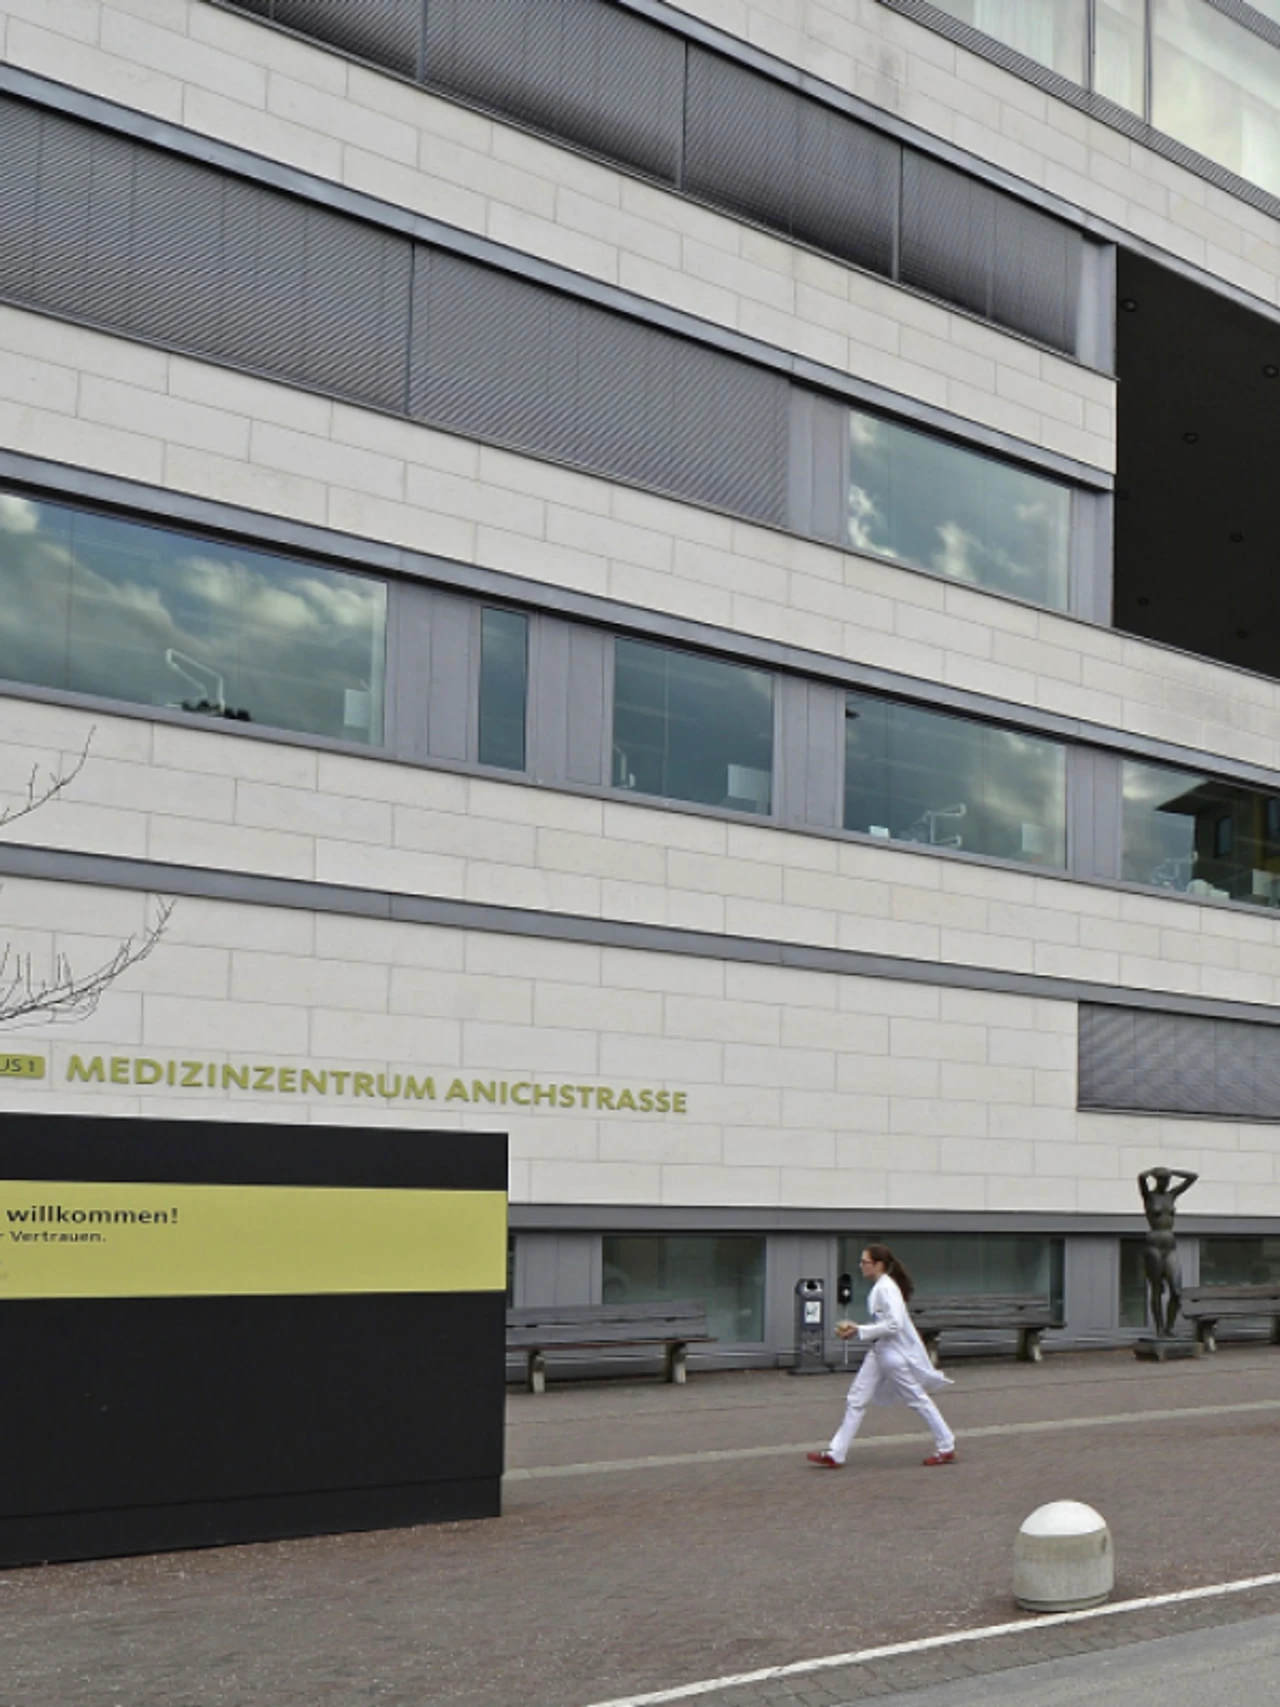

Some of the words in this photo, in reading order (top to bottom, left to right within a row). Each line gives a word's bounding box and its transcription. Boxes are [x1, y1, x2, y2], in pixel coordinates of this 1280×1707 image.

[28, 1059, 35, 1072] 1
[66, 1054, 437, 1100] MEDIZINZENTRUM
[445, 1078, 688, 1114] ANICHSTRASSE
[6, 1205, 178, 1224] willkommen!
[9, 1230, 107, 1243] Vertrauen.
